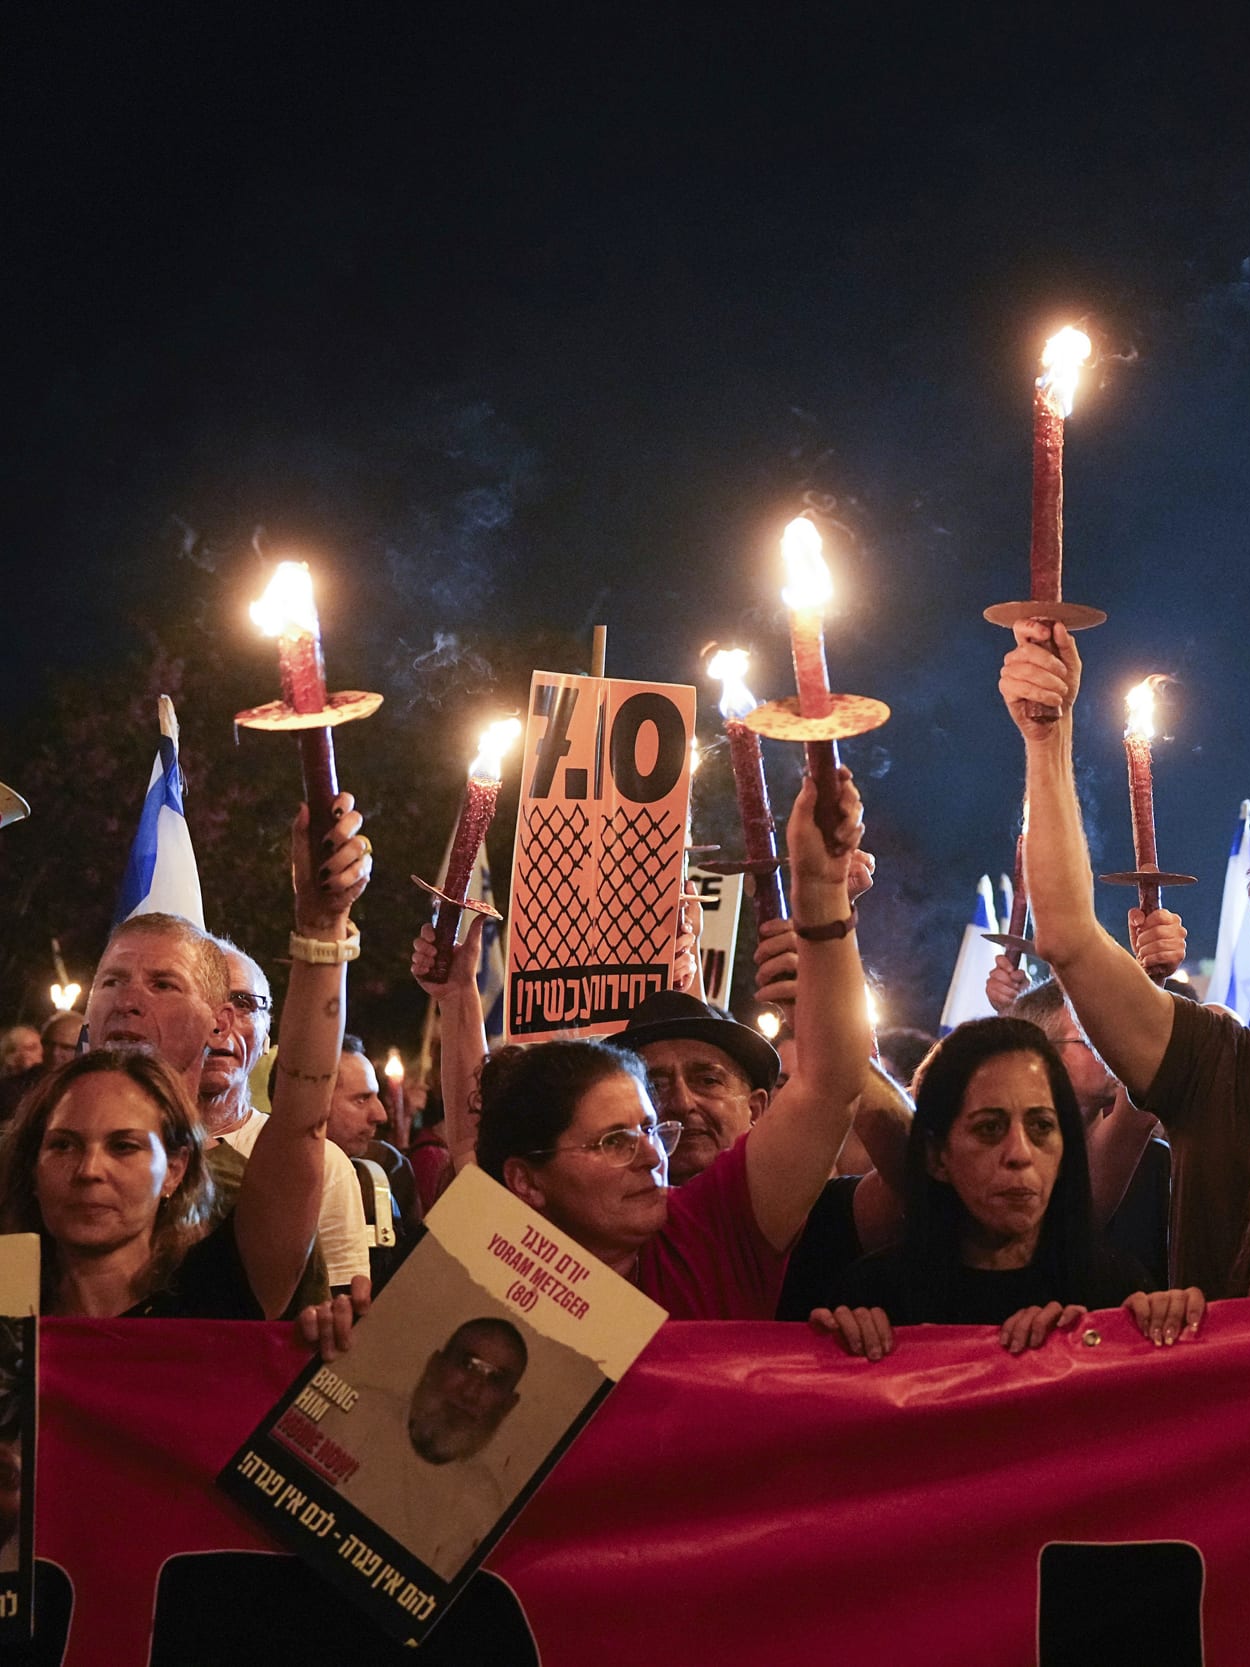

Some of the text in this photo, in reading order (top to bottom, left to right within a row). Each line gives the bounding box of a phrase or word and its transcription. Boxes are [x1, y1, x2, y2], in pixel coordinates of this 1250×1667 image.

[520, 1224, 591, 1284] יורם מצגר
[487, 1233, 590, 1320] YORAM METZGER
[505, 1280, 539, 1313] (80)
[295, 1387, 330, 1421] HIM
[312, 1367, 359, 1412] BRING
[236, 1450, 286, 1496] פגרה!
[273, 1484, 308, 1516] אין
[298, 1502, 336, 1538] לכם
[338, 1534, 384, 1576] פגרה
[370, 1564, 406, 1597] אין
[396, 1582, 437, 1621] להם
